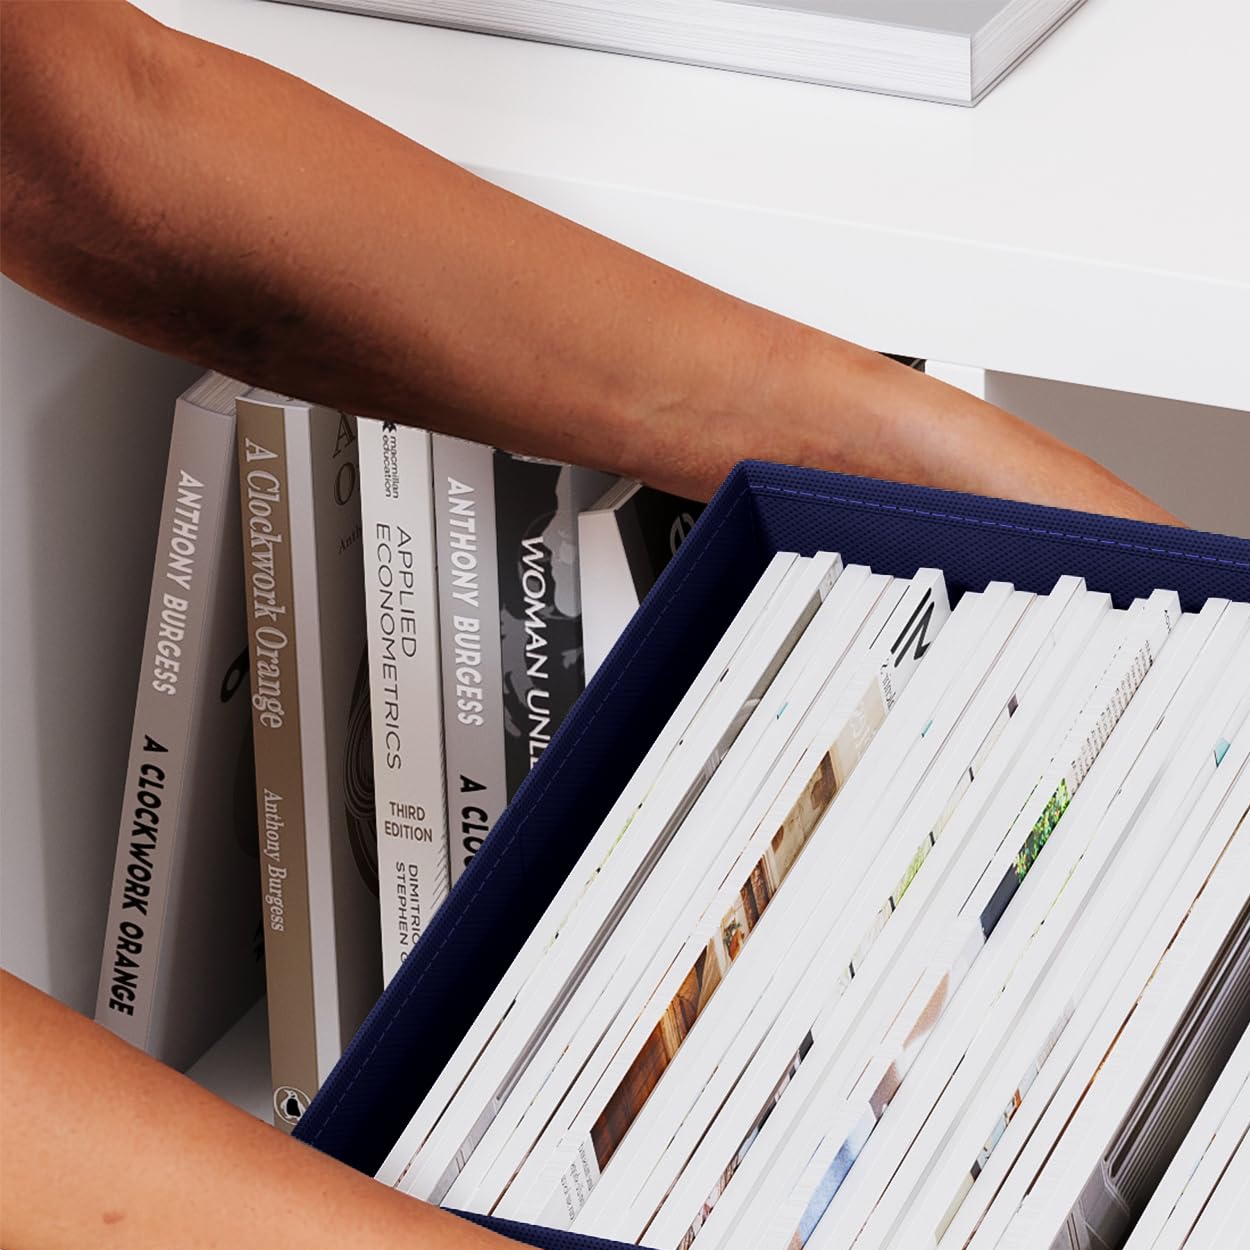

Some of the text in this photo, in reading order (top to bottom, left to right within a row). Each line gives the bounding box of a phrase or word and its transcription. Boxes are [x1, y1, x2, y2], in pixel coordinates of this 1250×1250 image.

[382, 434, 392, 498] education
[390, 435, 400, 499] macmillan
[152, 469, 205, 696] ANTHONY BURGESS
[245, 437, 289, 730] A Clockwork Orange
[376, 522, 402, 770] ECONOMETRICS
[396, 525, 417, 658] APPLIED
[447, 476, 484, 727] ANTHONY BURGESS
[521, 536, 550, 679] WOMAN
[384, 820, 433, 843] EDITION
[389, 801, 425, 822] THIRD
[459, 774, 487, 793] A
[108, 733, 170, 1017] A CLOCKWORK ORANGE
[263, 787, 288, 933] Anthony Burgess
[395, 861, 409, 946] STEPHEN
